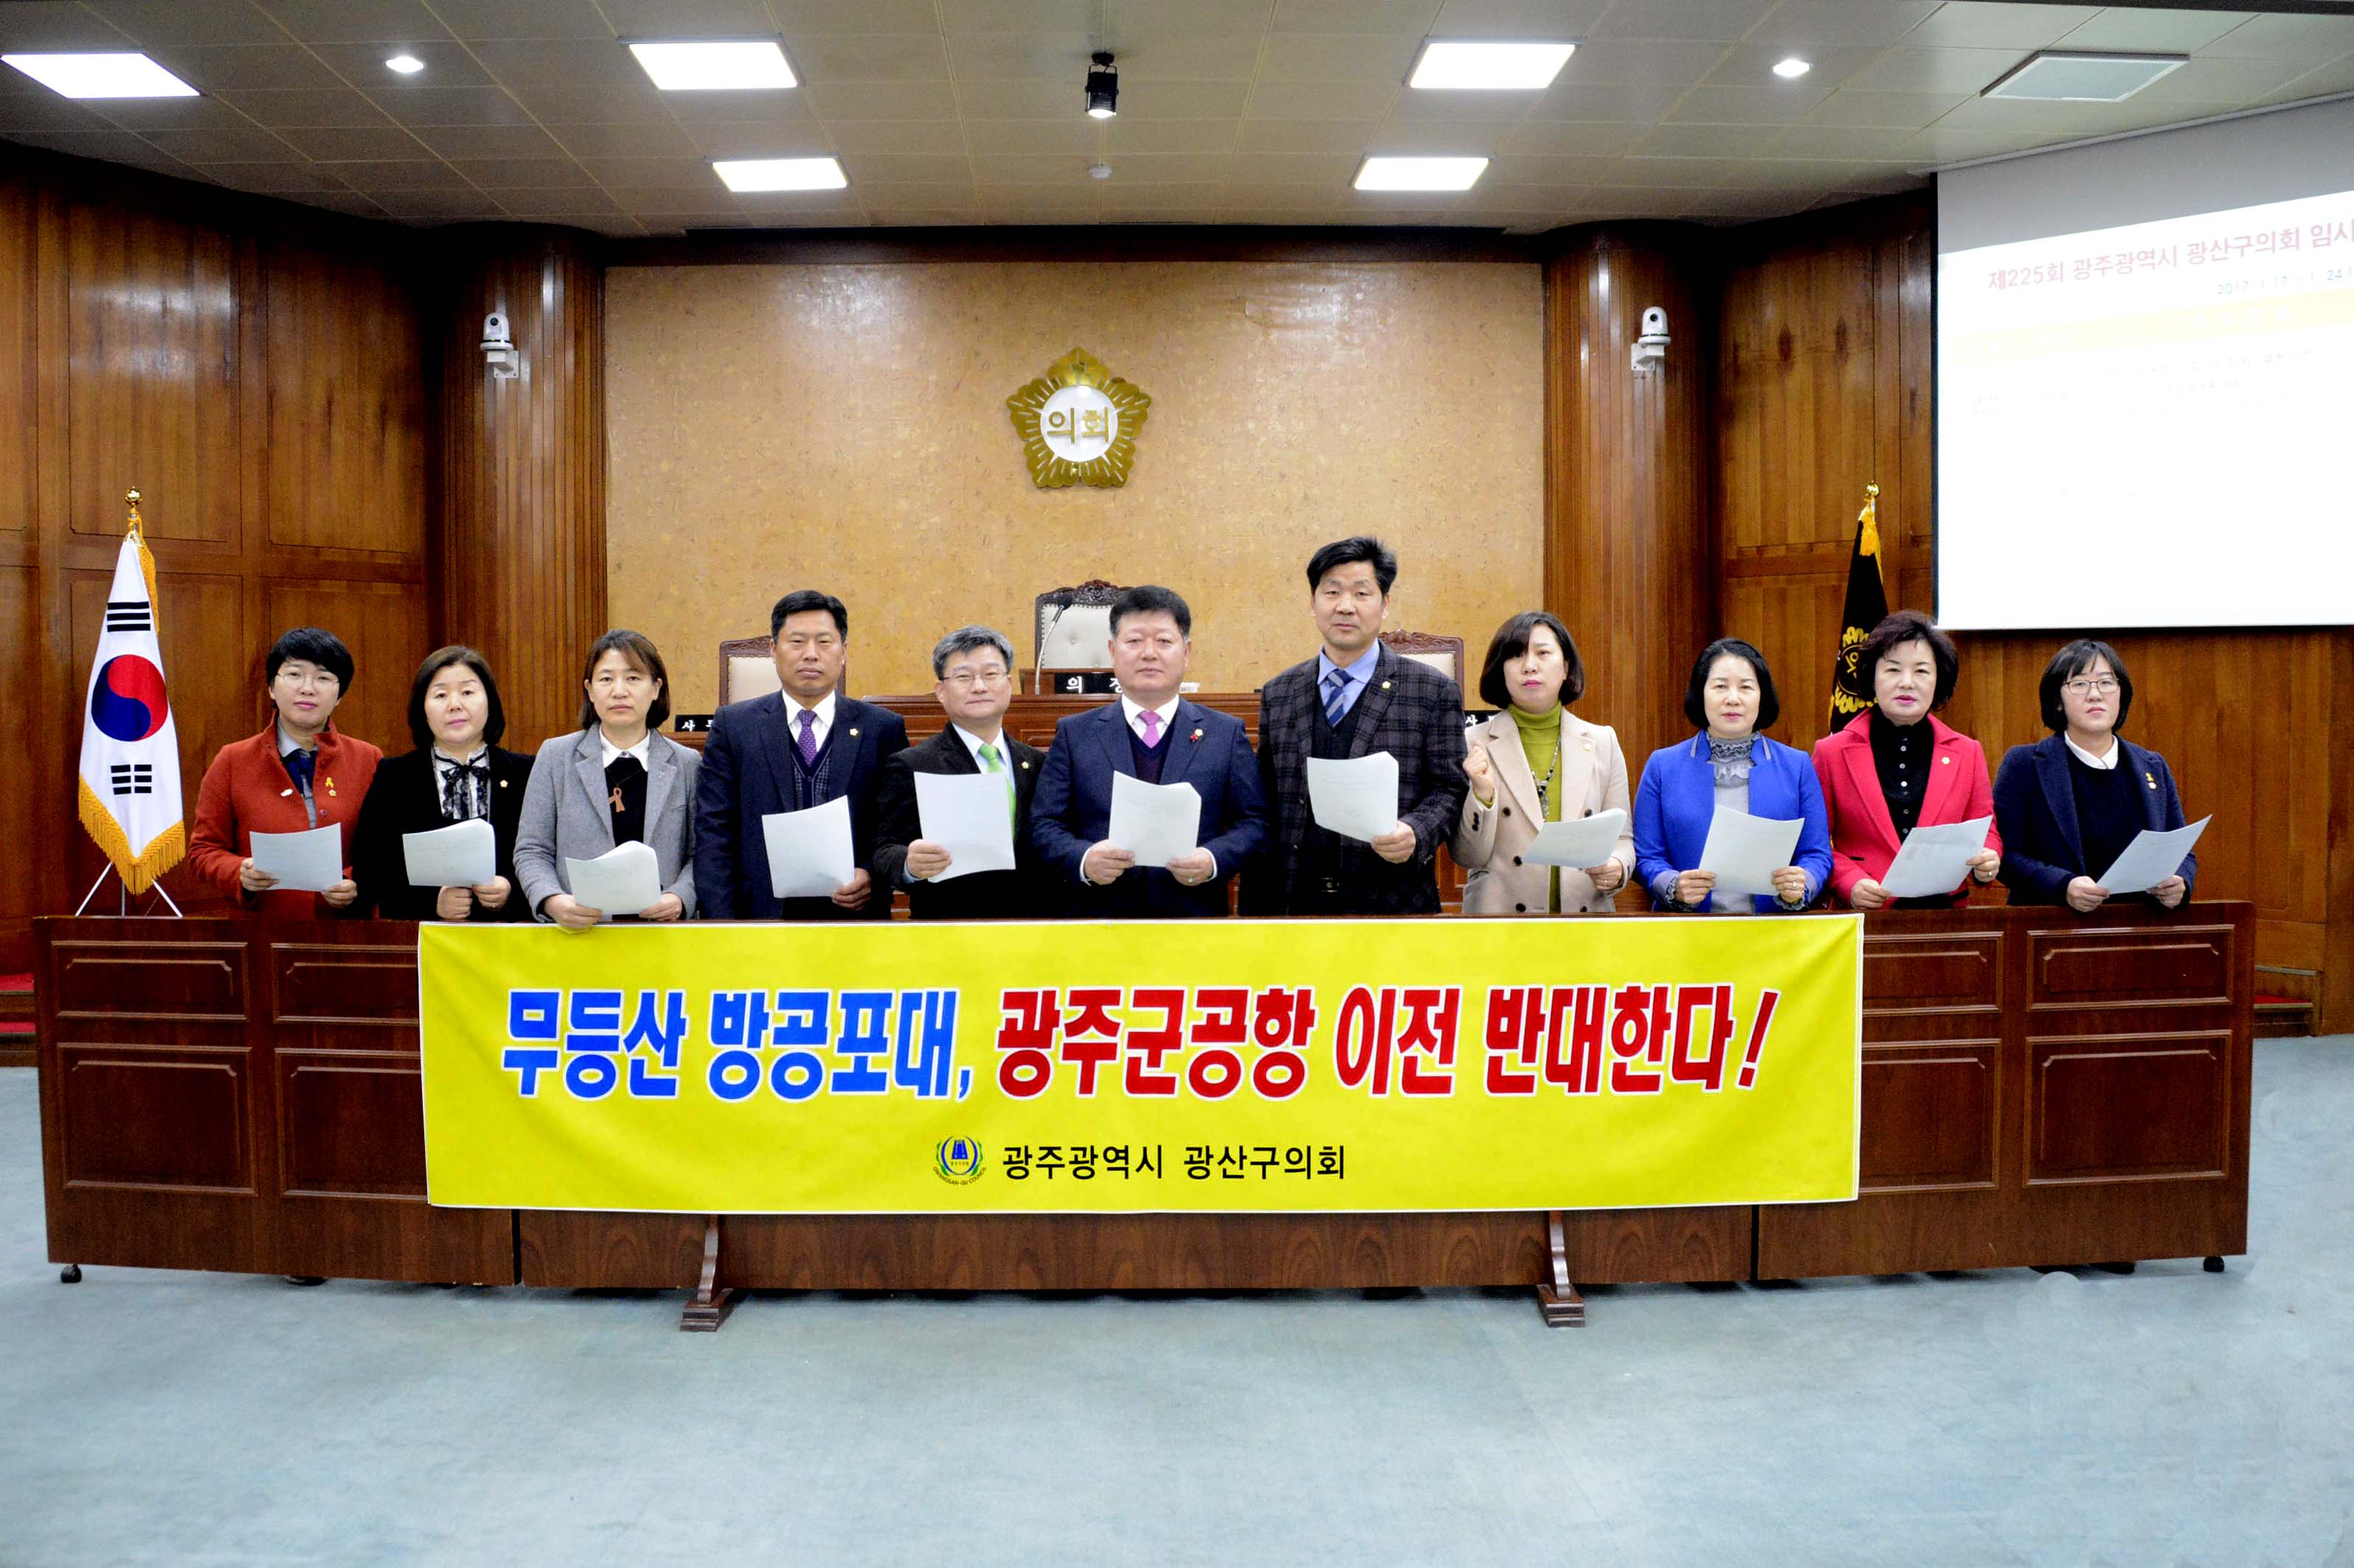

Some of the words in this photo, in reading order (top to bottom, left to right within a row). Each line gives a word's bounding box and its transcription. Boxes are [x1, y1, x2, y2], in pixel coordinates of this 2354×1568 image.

[1987, 261, 2065, 290] 제225회
[2072, 245, 2178, 281] 광주광역시
[2186, 227, 2300, 265] 광산구의회
[1046, 406, 1110, 444] 의회
[502, 989, 688, 1100] 무등산
[707, 988, 972, 1102] 방공포대,
[996, 987, 1317, 1099] 광주군공항
[1335, 985, 1461, 1097] 이전
[1484, 984, 1779, 1096] 반대한다!
[1002, 1145, 1162, 1180] 광주광역시
[1184, 1145, 1345, 1180] 광산구의회
